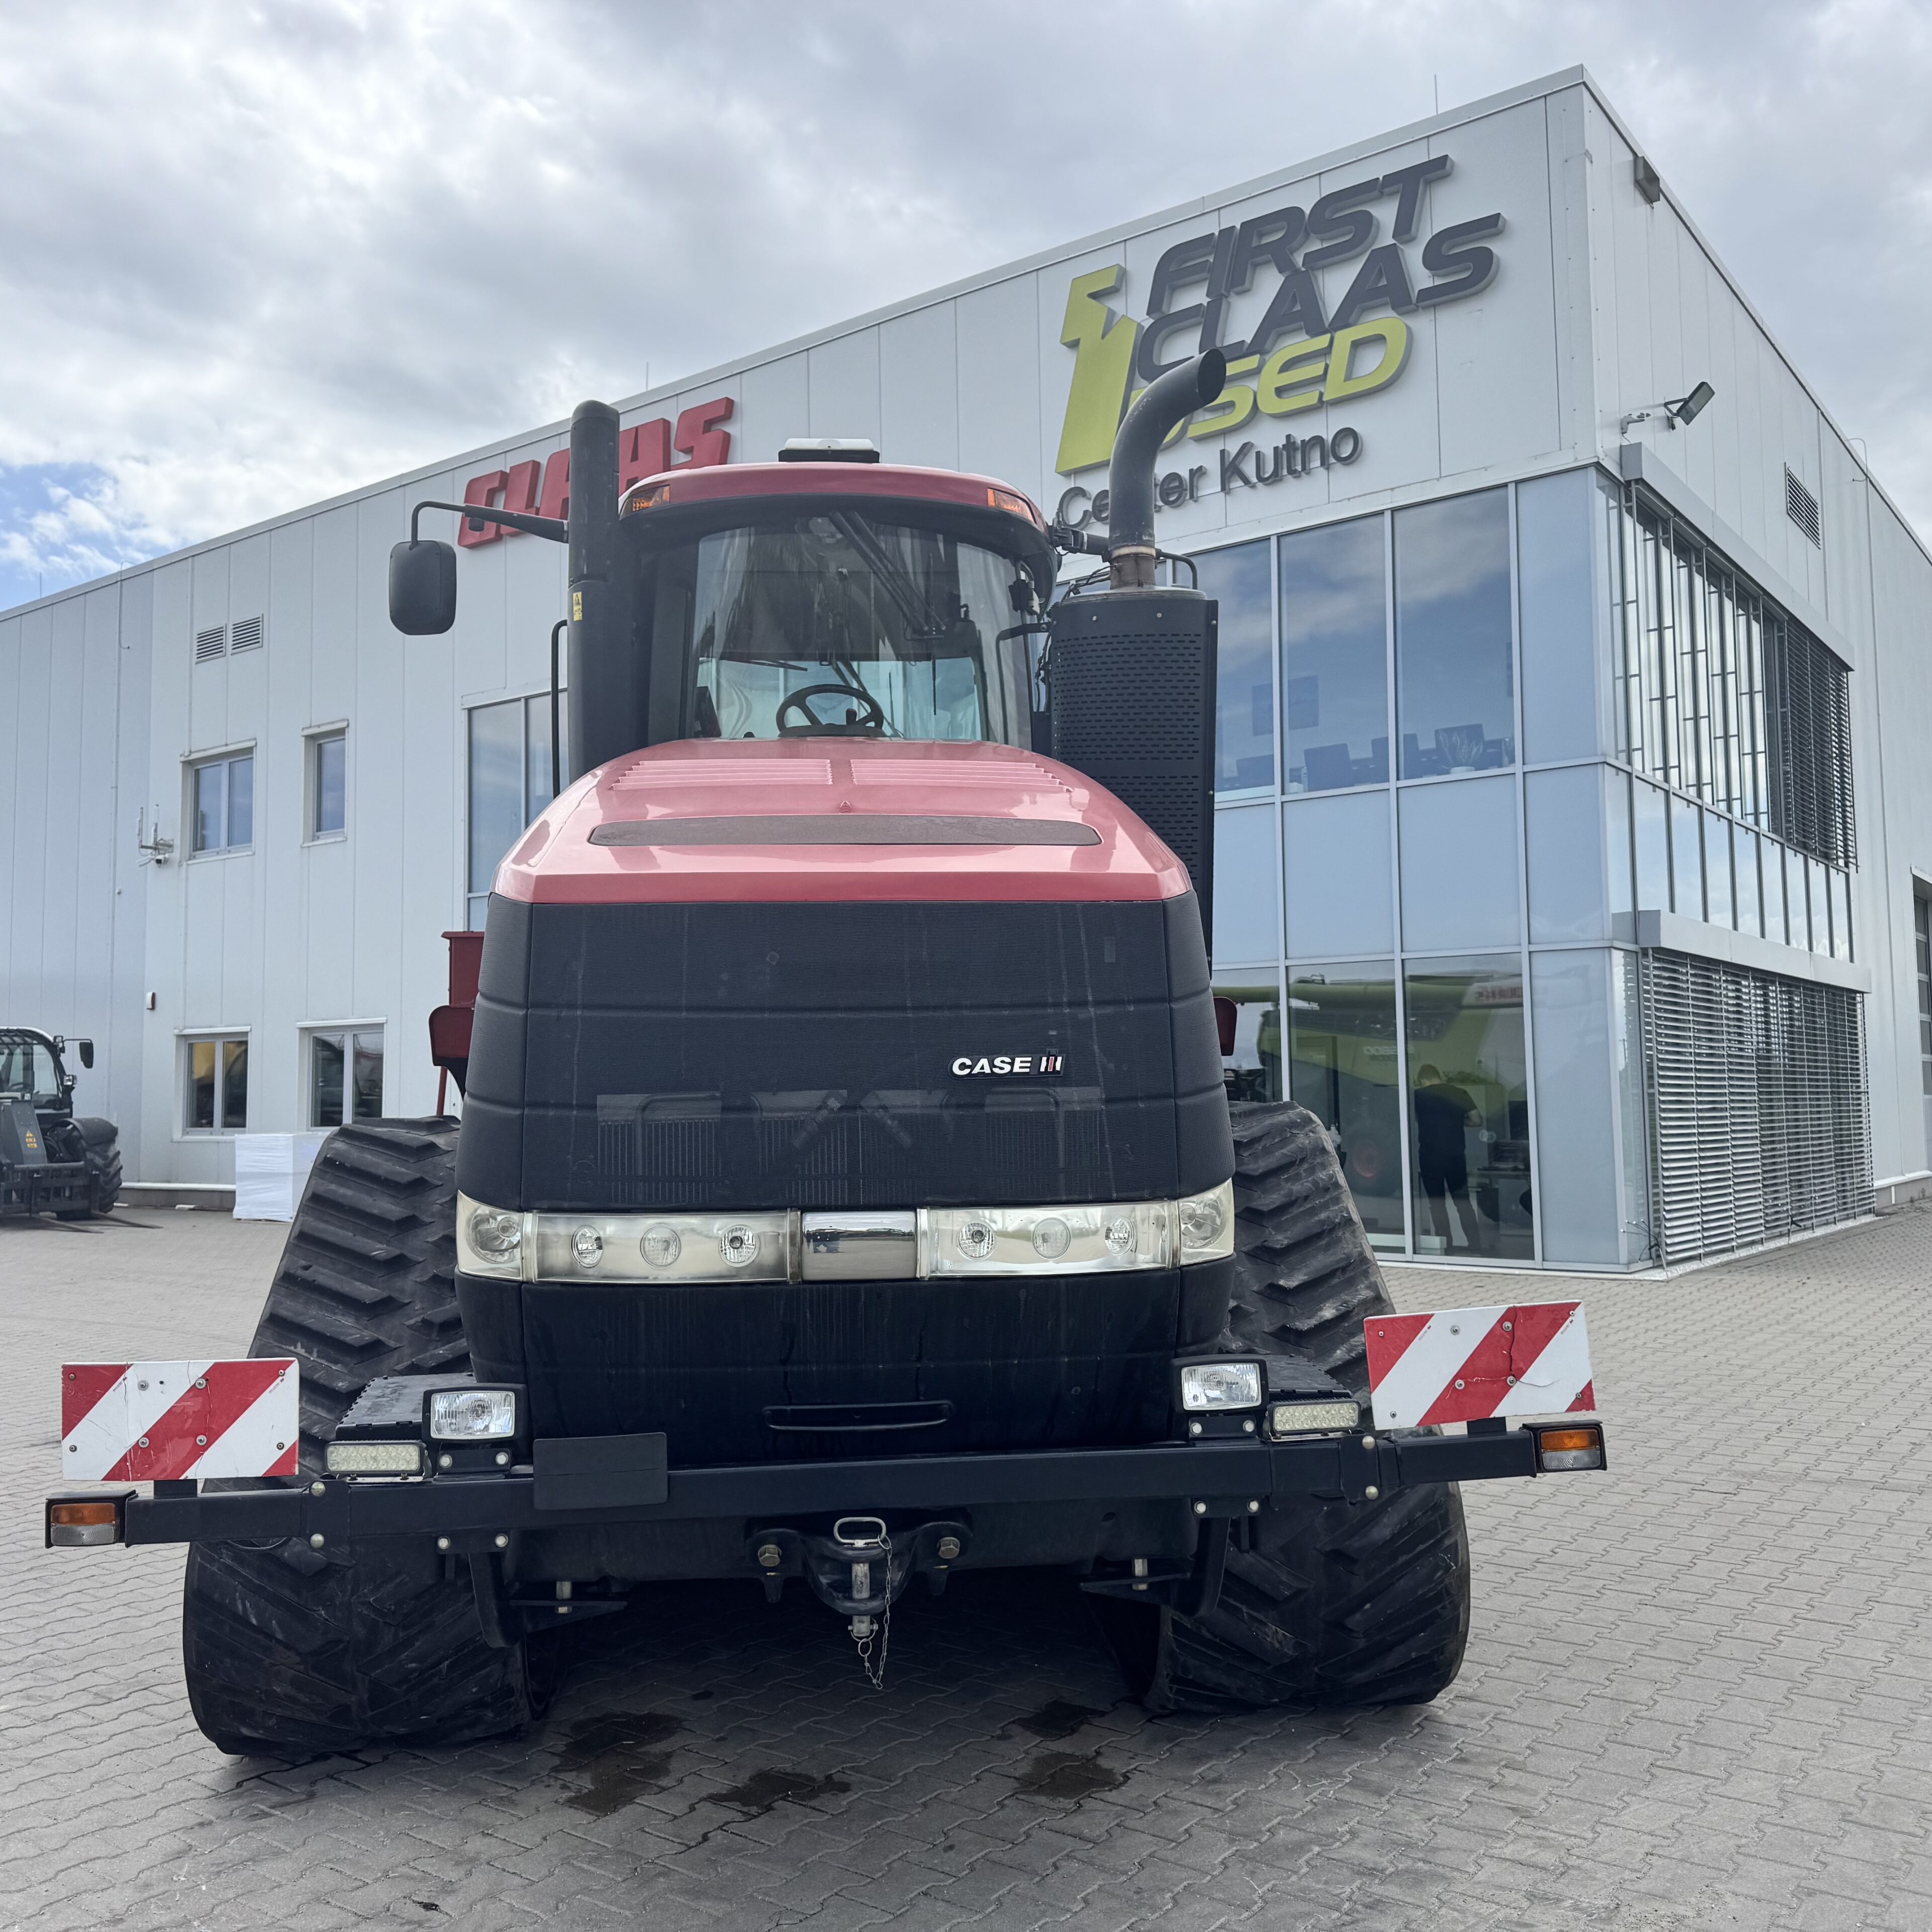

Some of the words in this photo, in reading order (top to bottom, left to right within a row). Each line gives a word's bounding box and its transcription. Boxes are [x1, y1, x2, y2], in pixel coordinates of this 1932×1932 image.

[1136, 212, 1506, 383] CLAAS
[1146, 154, 1454, 320] FIRST
[1129, 317, 1412, 451] SED
[1058, 465, 1206, 529] Ceer
[1219, 427, 1363, 494] Kutno
[952, 1057, 1032, 1075] CASE
